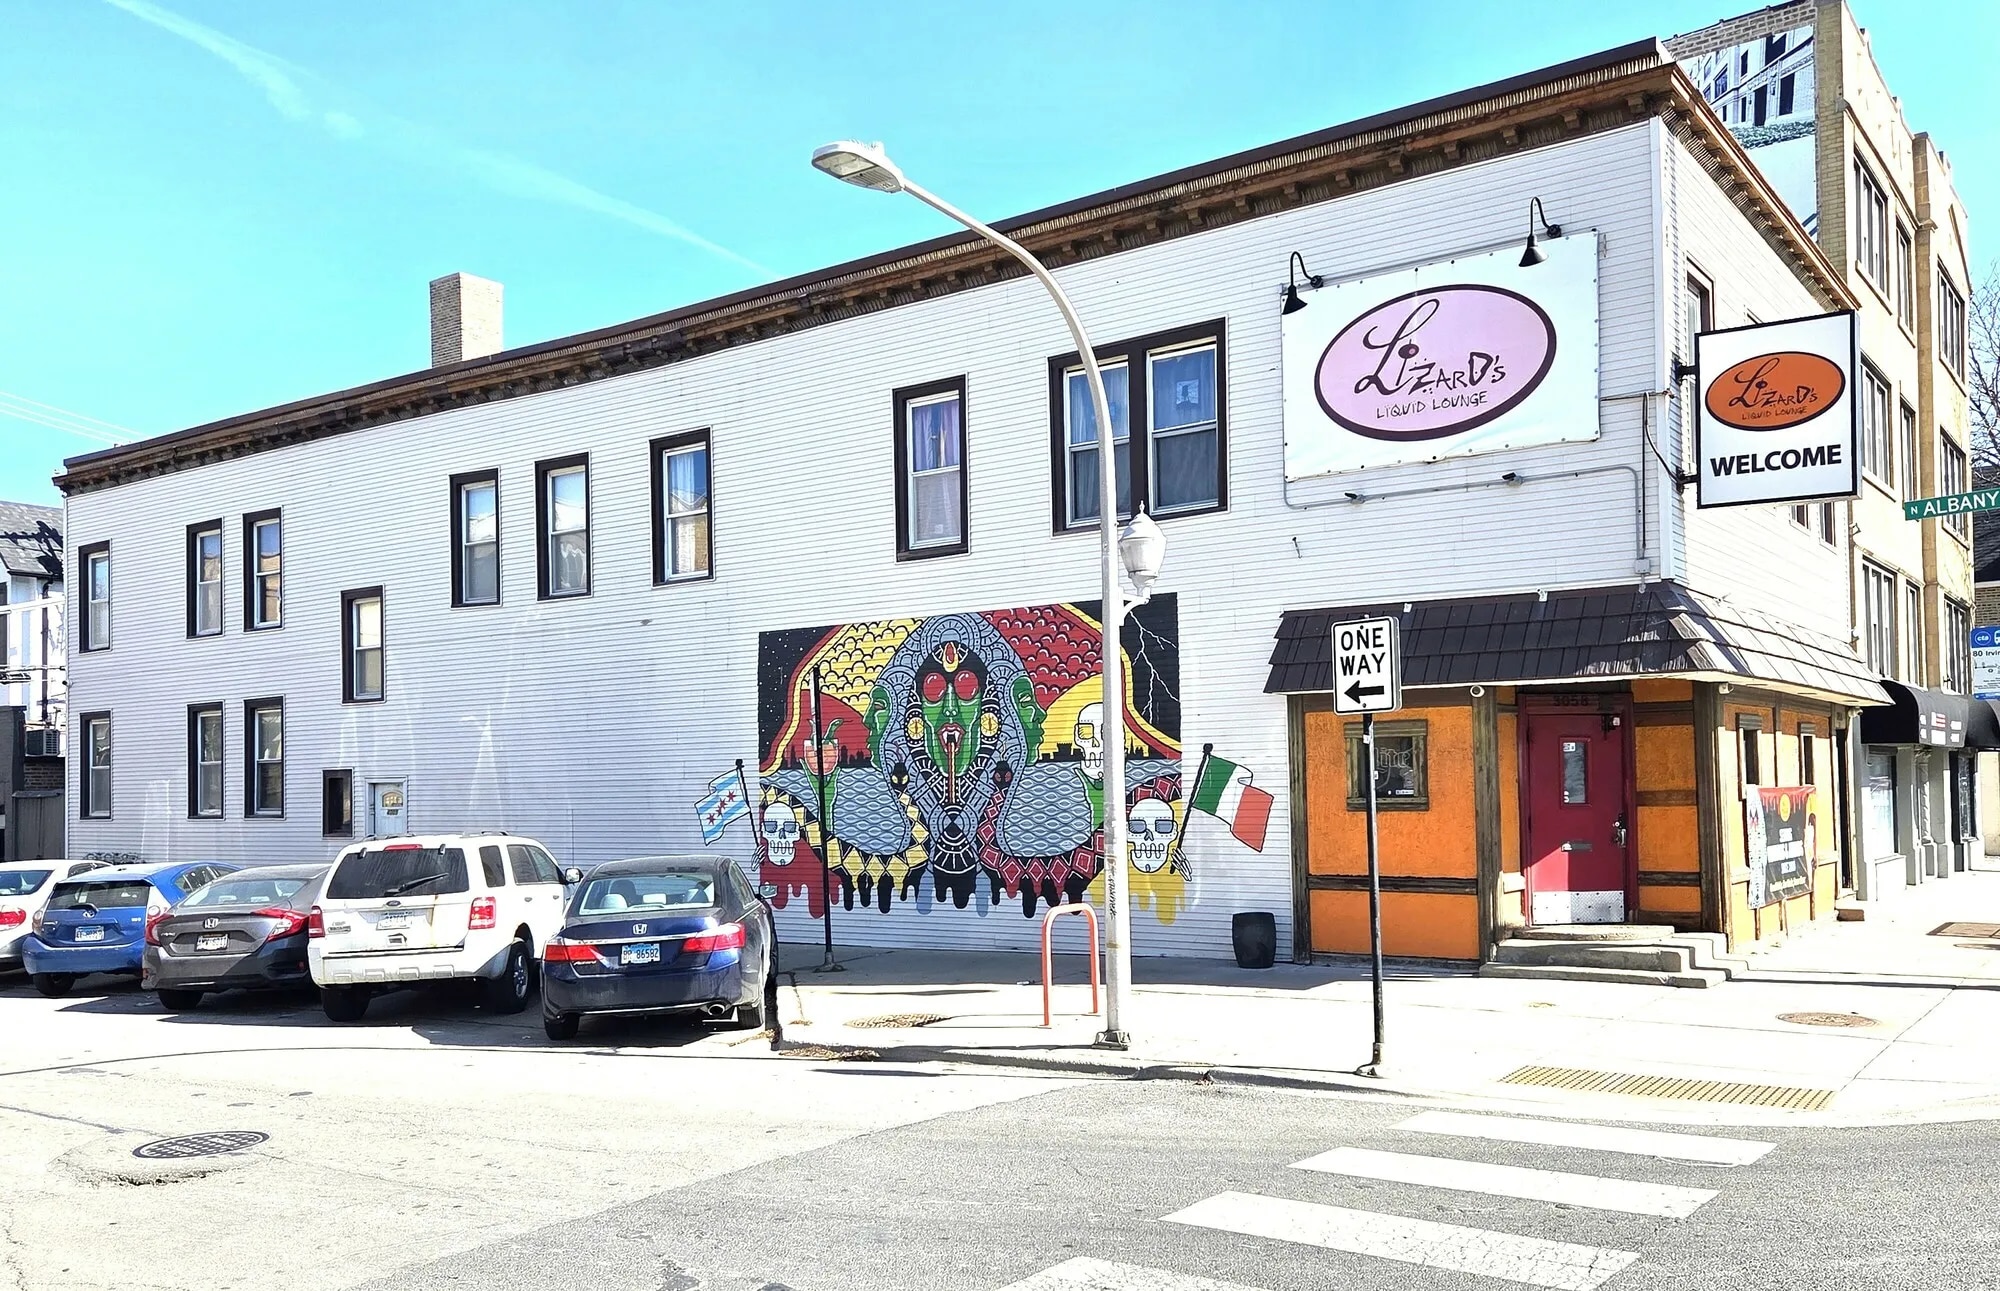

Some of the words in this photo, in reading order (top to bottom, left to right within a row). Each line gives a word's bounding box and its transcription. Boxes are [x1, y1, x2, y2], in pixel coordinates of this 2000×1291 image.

[1376, 400, 1426, 419] LIQUID
[1432, 390, 1488, 410] LOUNGE
[1742, 410, 1772, 420] LIQUID
[1775, 406, 1807, 416] LOUNGE
[1710, 444, 1842, 477] WELCOME
[1910, 505, 1918, 515] N
[1923, 490, 2000, 516] ALBANY
[1341, 627, 1384, 651] ONE
[1340, 652, 1386, 676] WAY
